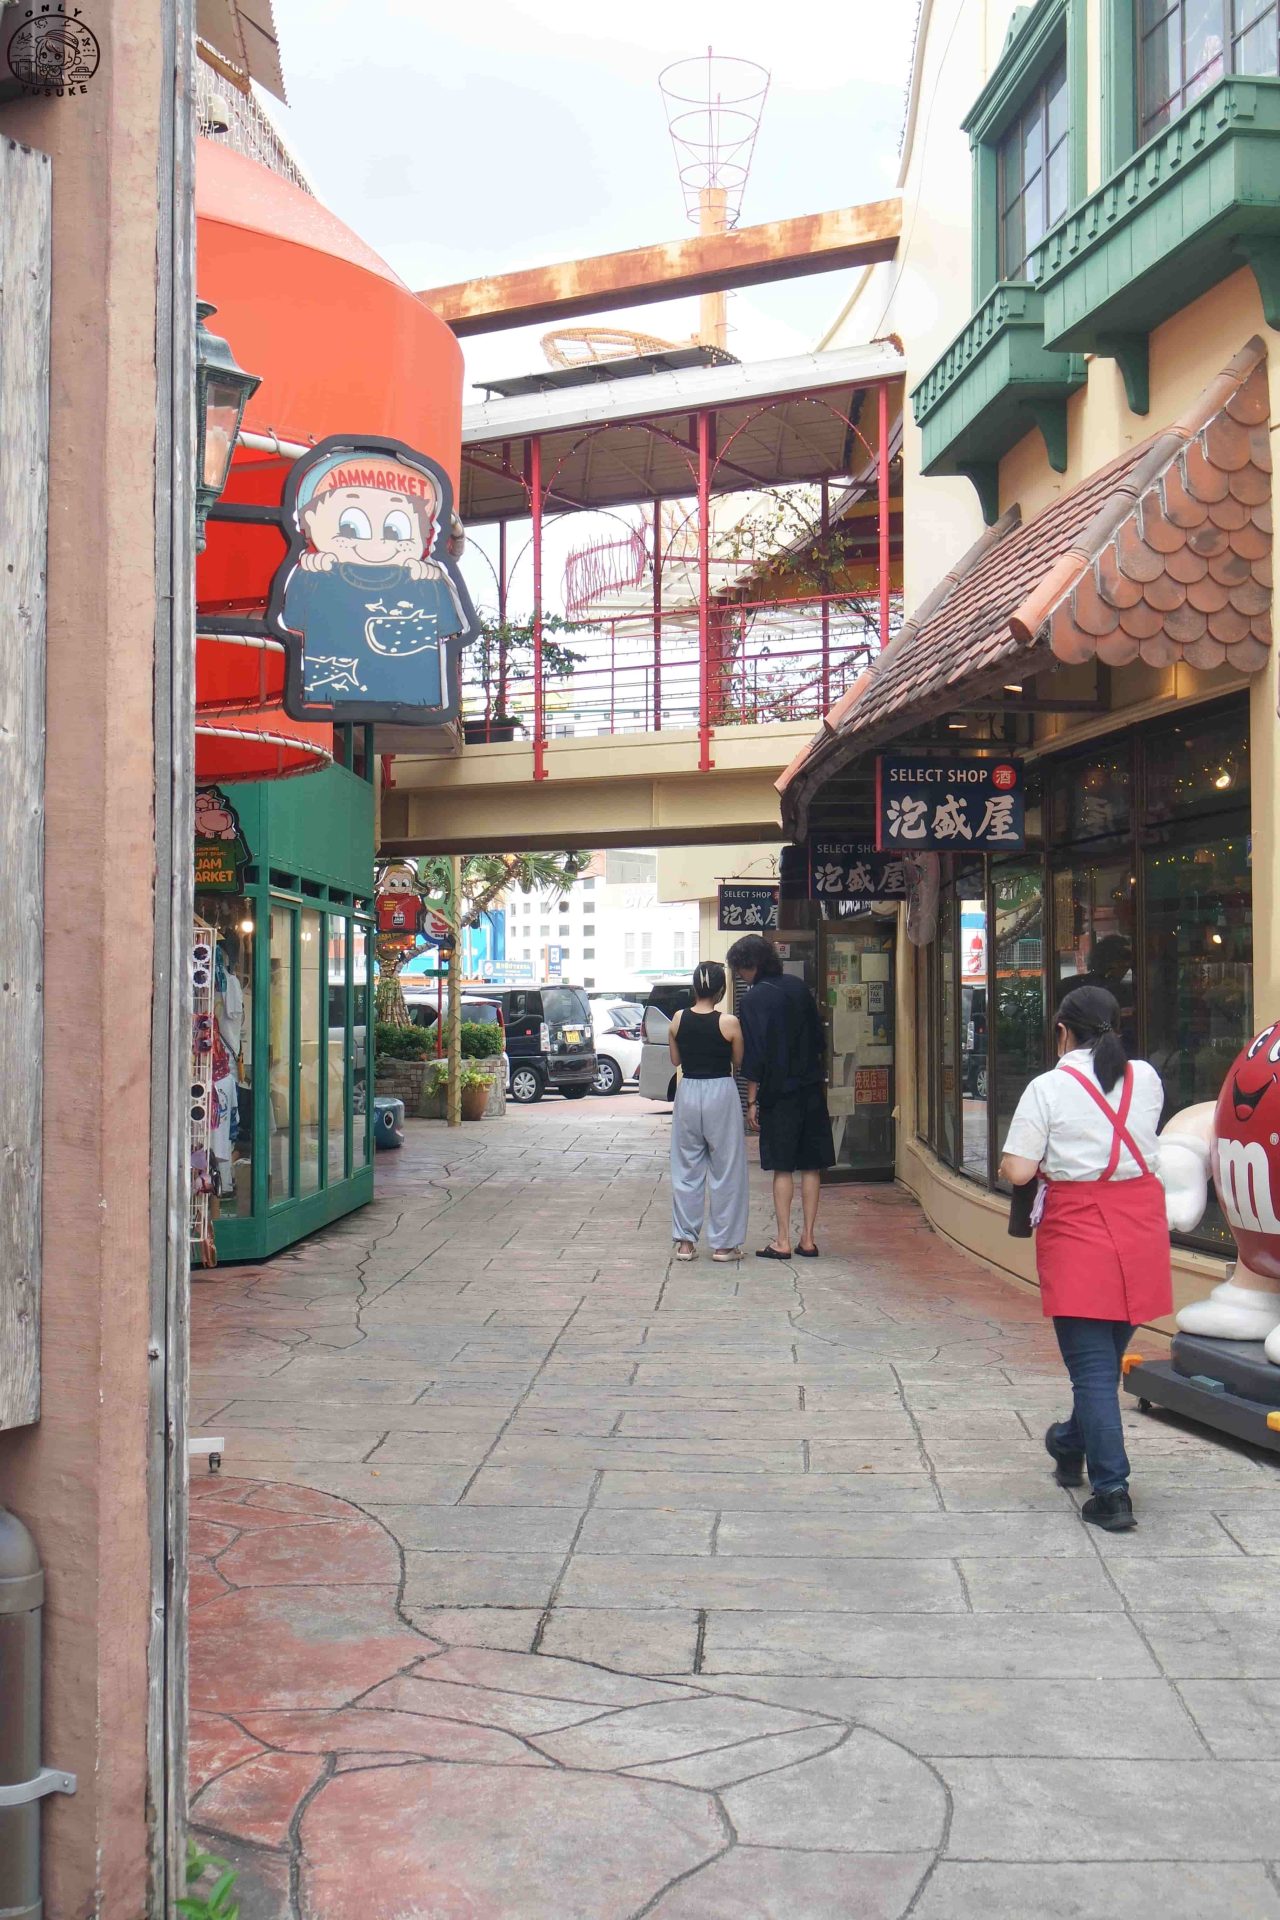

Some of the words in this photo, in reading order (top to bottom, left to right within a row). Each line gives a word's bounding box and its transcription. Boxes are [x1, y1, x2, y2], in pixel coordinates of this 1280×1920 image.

[328, 469, 427, 497] JAMMARKET
[890, 769, 943, 782] SELECT
[947, 769, 988, 783] SHOP
[995, 770, 1012, 785] 酒
[886, 794, 1019, 841] 泡盛屋
[817, 844, 855, 853] SELECT
[857, 844, 877, 853] SHO
[195, 857, 222, 870] JAM
[195, 870, 234, 883] ARKET
[815, 861, 906, 893] 泡盛屋
[724, 890, 750, 899] SELECT
[751, 891, 772, 899] SHOP
